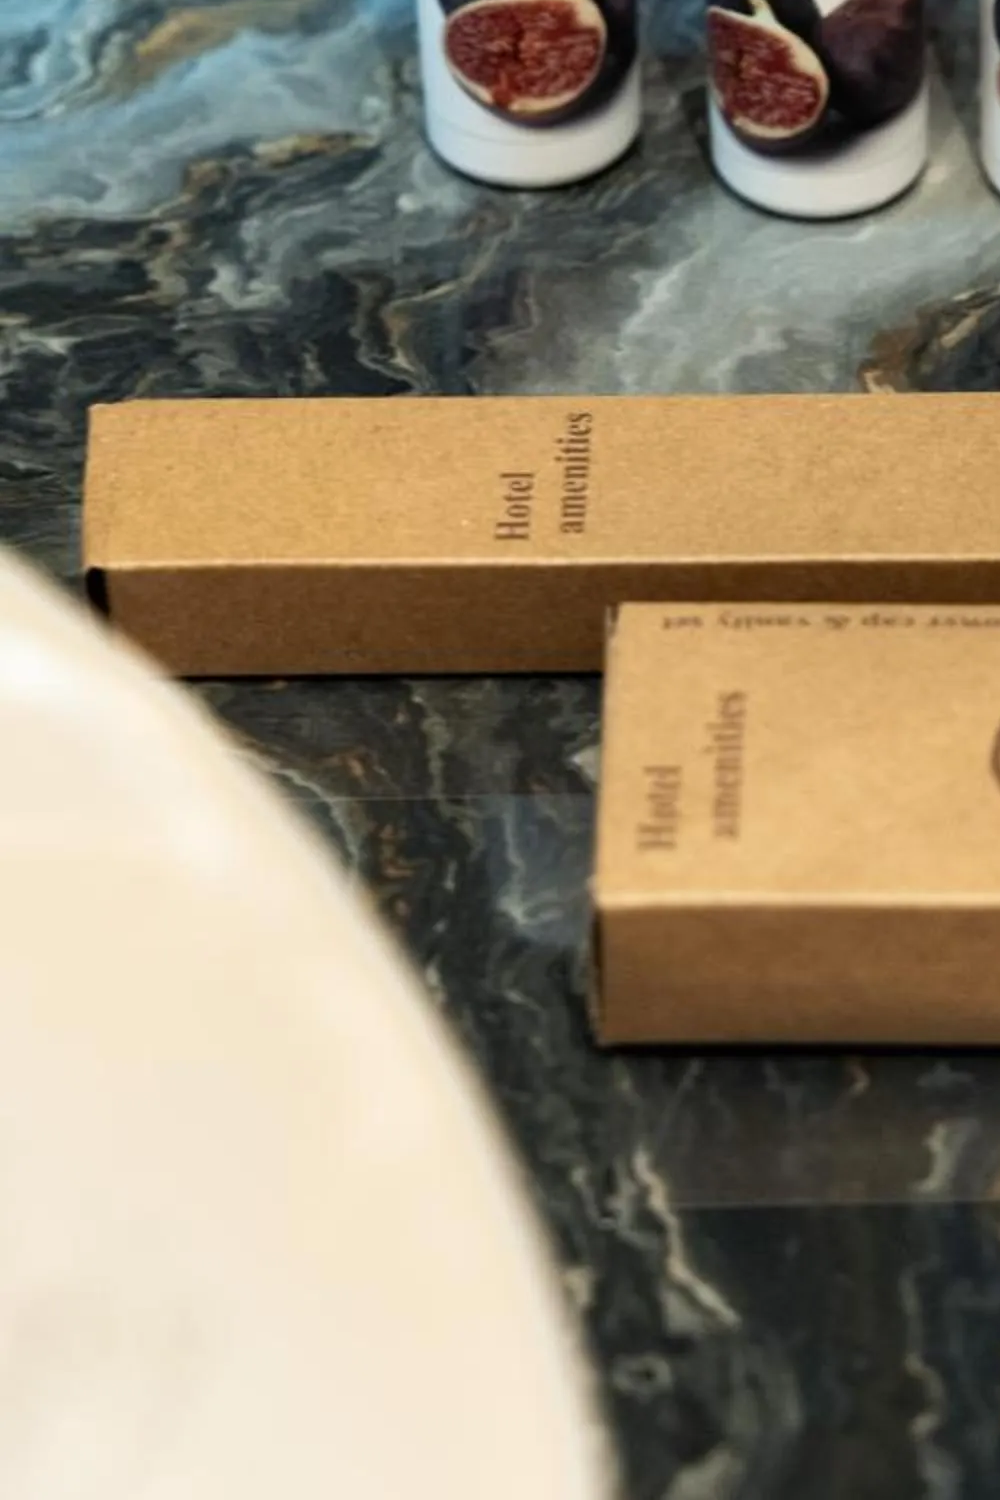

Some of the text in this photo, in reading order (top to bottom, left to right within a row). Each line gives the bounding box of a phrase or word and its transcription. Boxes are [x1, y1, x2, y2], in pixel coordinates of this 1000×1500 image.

[494, 472, 535, 540] Hotel
[554, 412, 593, 534] amenities
[662, 614, 702, 631] set
[824, 614, 851, 631] &
[861, 613, 915, 628] cap
[702, 691, 747, 839] amenities
[636, 764, 682, 851] Hotel
